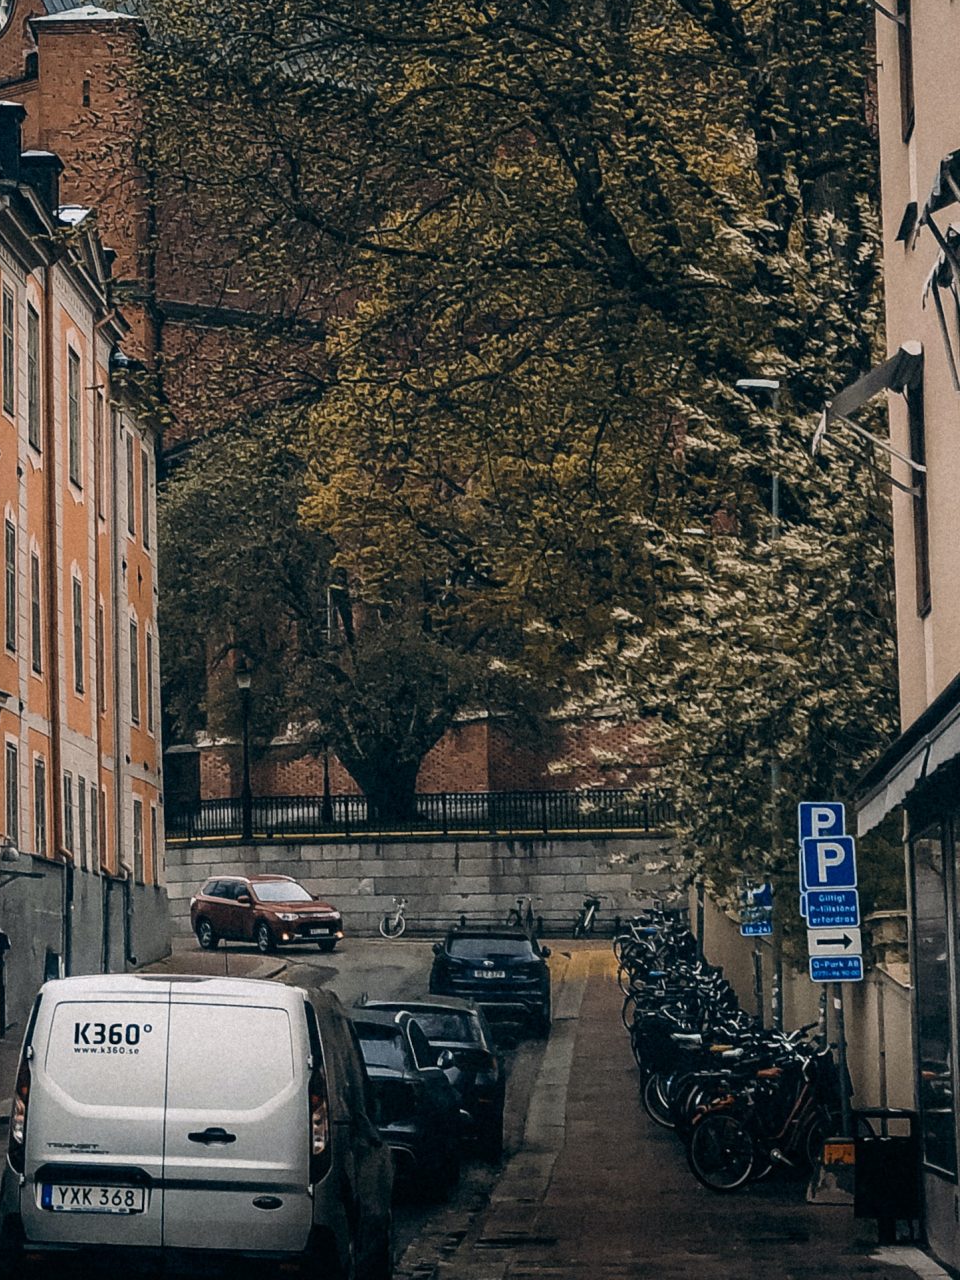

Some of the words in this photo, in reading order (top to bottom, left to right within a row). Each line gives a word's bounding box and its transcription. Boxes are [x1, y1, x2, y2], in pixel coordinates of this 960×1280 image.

[811, 807, 836, 838] P
[816, 842, 845, 883] P
[818, 894, 846, 903] Giltigt
[812, 916, 855, 924] erfordras
[813, 960, 844, 968] Q-Park
[847, 959, 859, 967] AB
[74, 1022, 152, 1045] K360°
[74, 1046, 139, 1054] www.k360.se
[59, 1187, 92, 1205] YXK
[99, 1189, 134, 1207] 368
